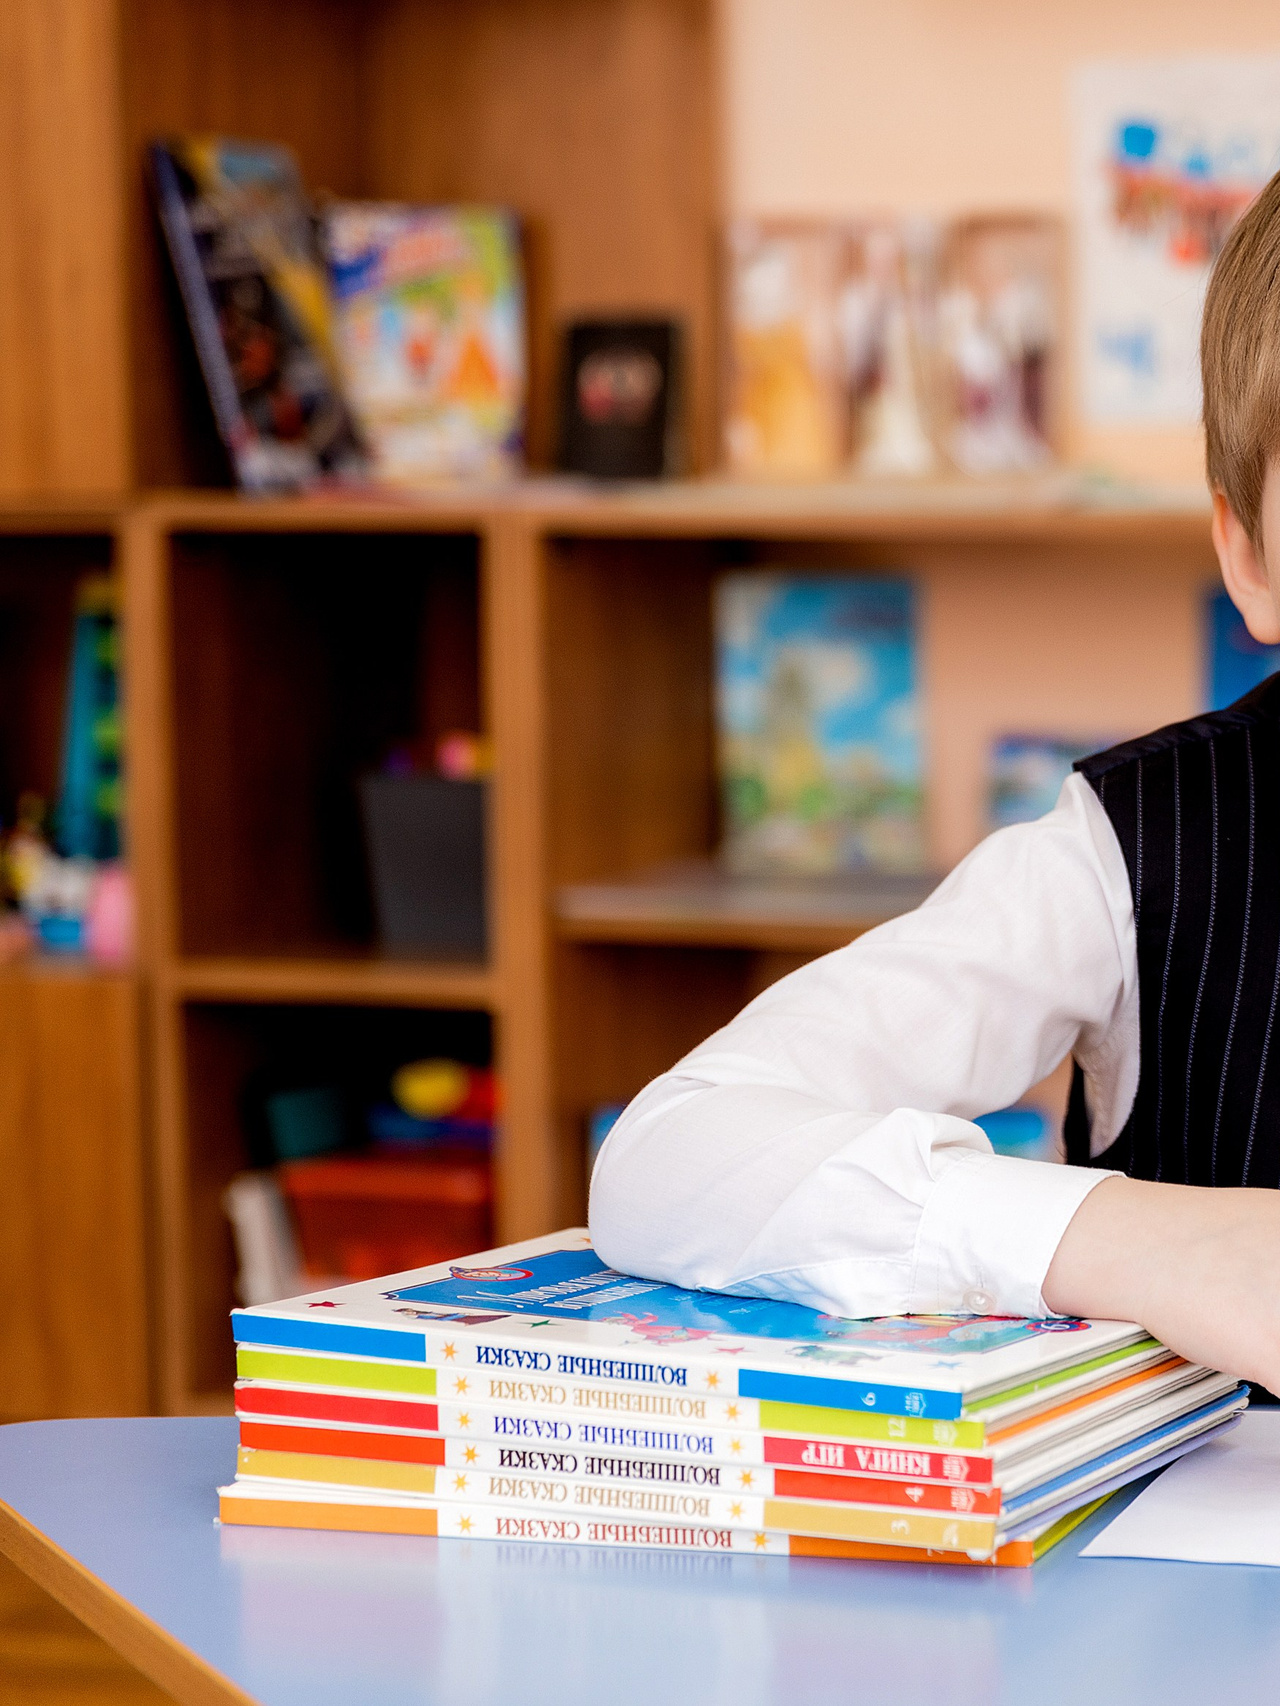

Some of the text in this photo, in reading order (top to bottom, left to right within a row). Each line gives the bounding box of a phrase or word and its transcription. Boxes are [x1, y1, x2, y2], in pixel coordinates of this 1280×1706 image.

[476, 1345, 688, 1386] ВОЛШЕБНЫЕ СКАЗКИ
[488, 1379, 708, 1420] ВОЛШЕБНЫЕ СКАЗКИ
[492, 1415, 714, 1455] ВОЛШЕБНЫЕ СКАЗКИ
[801, 1442, 845, 1467] ИГР
[498, 1448, 721, 1486] ВОЛШЕБНЫЕ СКАЗКИ
[855, 1447, 931, 1477] КНИГА
[488, 1476, 711, 1518] ВОЛШЕБНЫЕ СКАЗКИ
[496, 1516, 733, 1549] ВОЛШЕБНЫЕ СКАЗКИ
